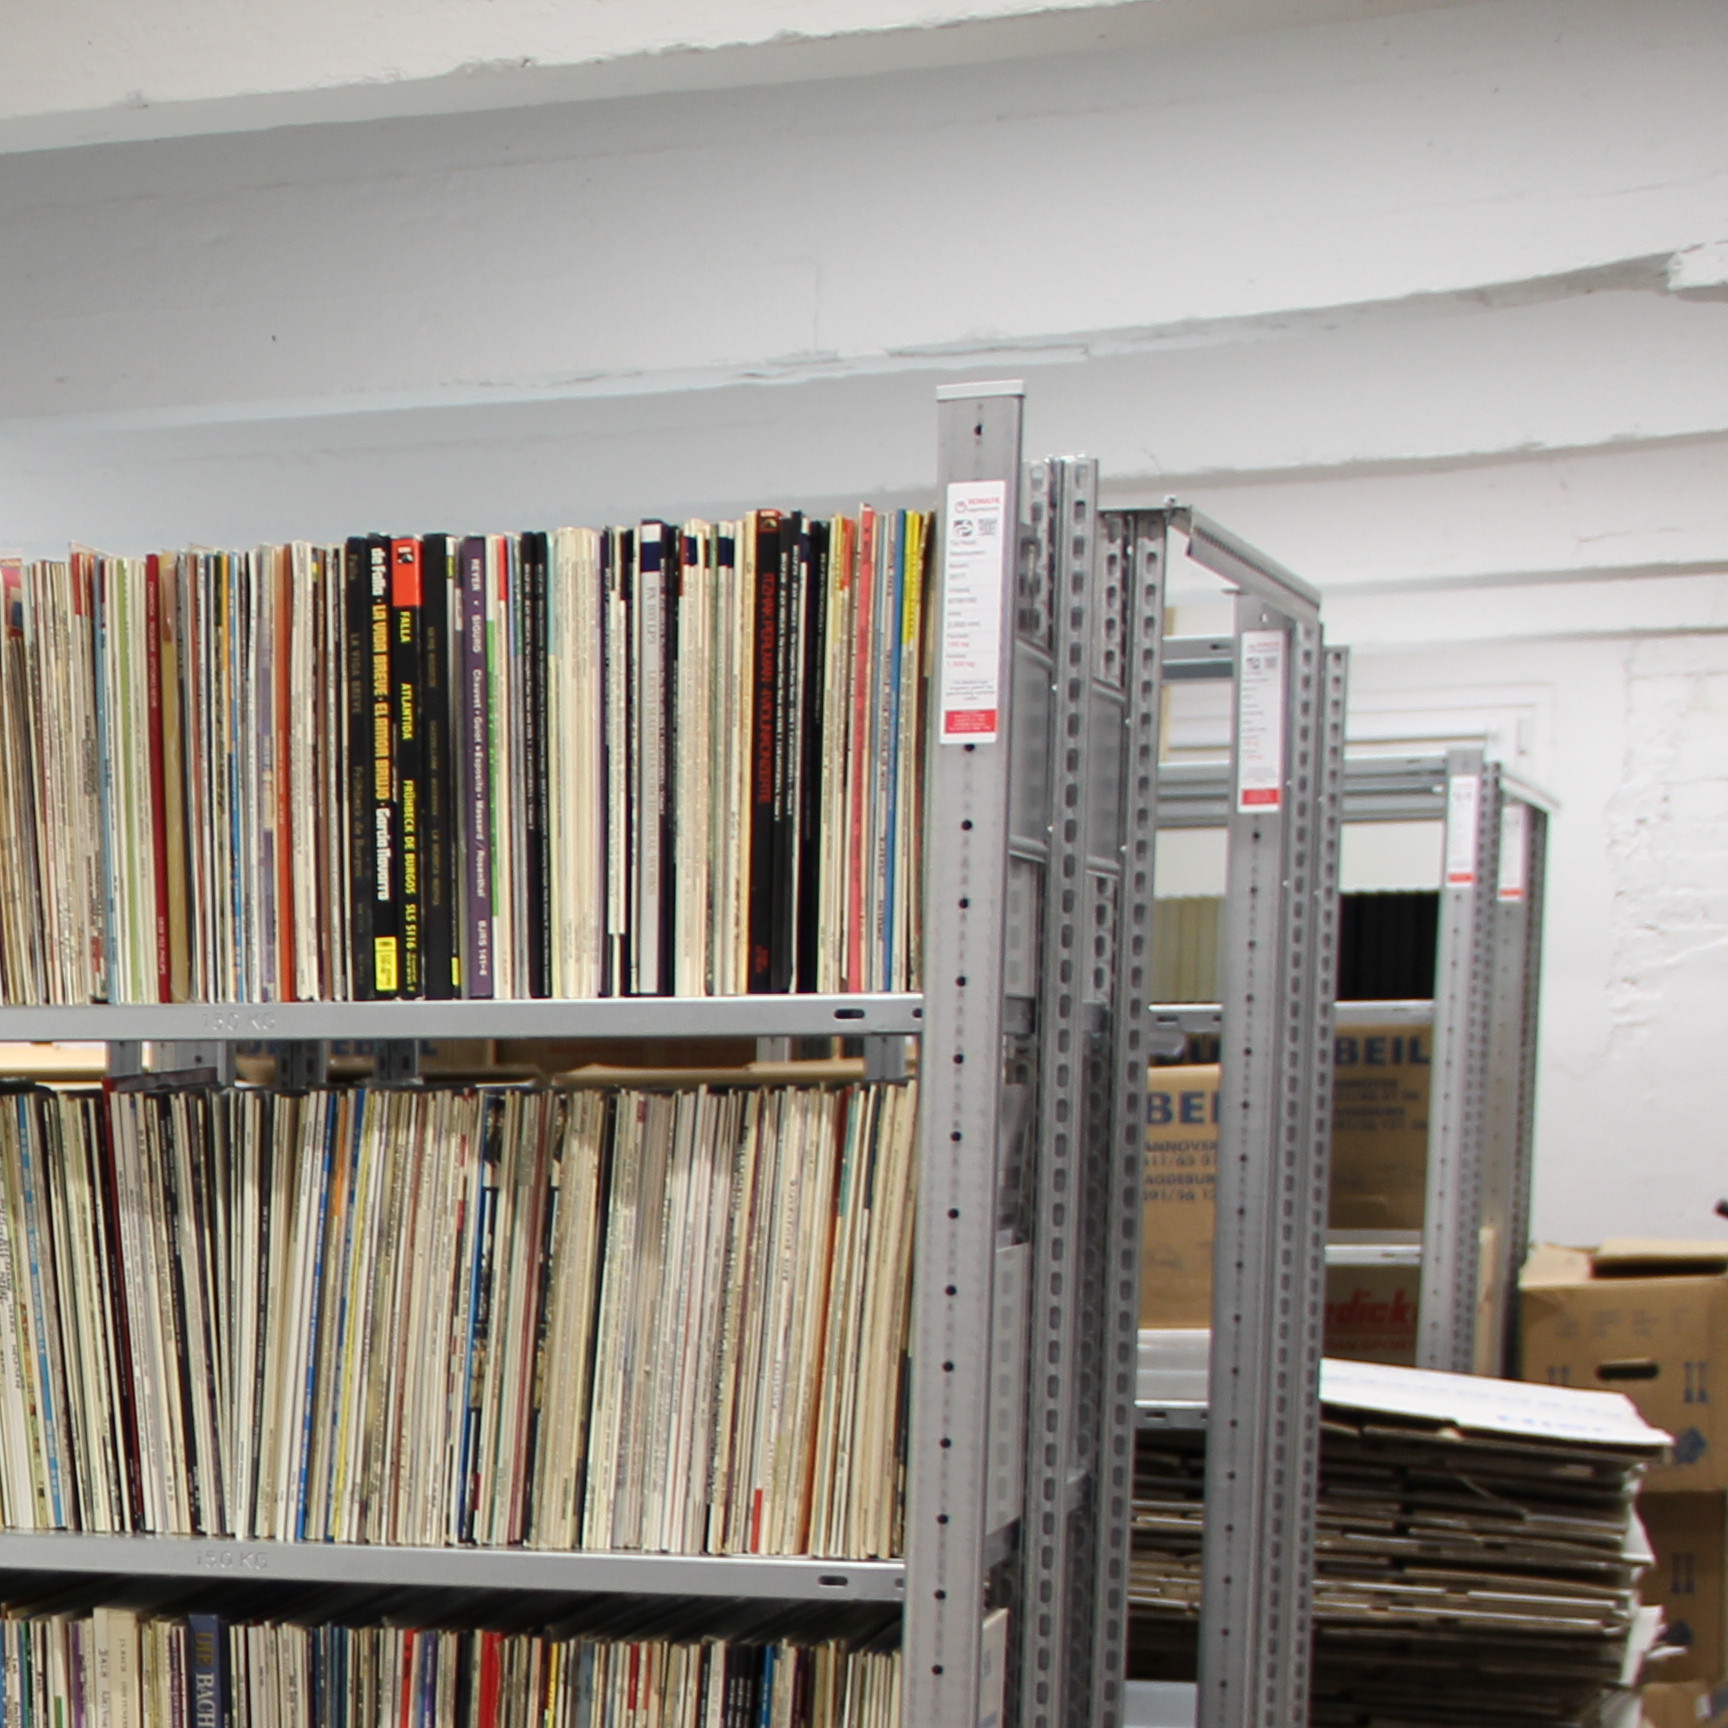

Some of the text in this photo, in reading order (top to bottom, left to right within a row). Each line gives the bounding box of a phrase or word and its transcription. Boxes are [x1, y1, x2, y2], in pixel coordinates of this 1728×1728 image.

[371, 548, 385, 562] de
[371, 566, 386, 596] Falla
[372, 605, 386, 617] LA
[400, 611, 411, 642] FALLA
[372, 621, 387, 652] VIDA
[372, 656, 388, 695] BREVE
[373, 703, 388, 715] EL
[401, 683, 413, 740] ATLANTIDA
[374, 718, 389, 756] AMOR
[374, 760, 389, 799] BRUJO
[404, 832, 415, 849] DE
[376, 849, 391, 900] Navarro
[404, 853, 416, 894] BURGOS
[405, 904, 417, 921] SLS
[405, 925, 417, 949] 5116
[197, 1673, 215, 1728] BACH
